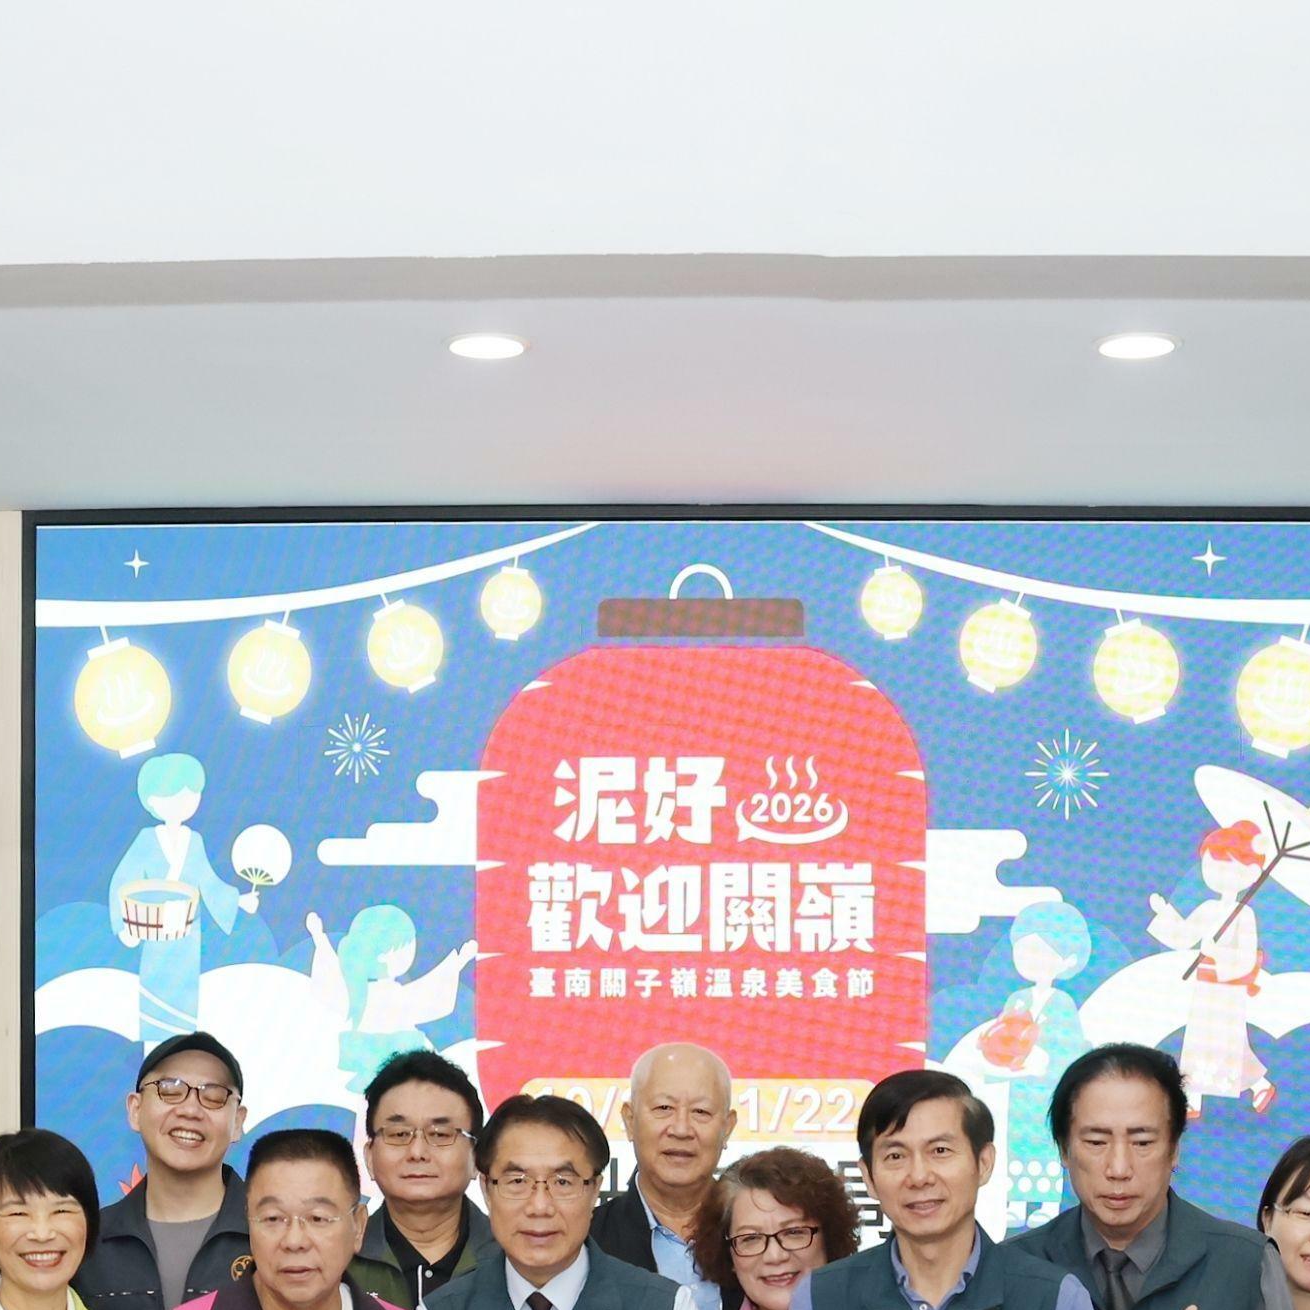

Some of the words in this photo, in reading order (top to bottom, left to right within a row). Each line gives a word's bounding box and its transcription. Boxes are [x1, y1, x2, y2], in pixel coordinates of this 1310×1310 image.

[553, 756, 727, 844] 泥好
[750, 793, 834, 823] 2026
[527, 862, 876, 953] 歡迎關嶺
[529, 967, 875, 998] 臺南關子嶺溫泉美食節
